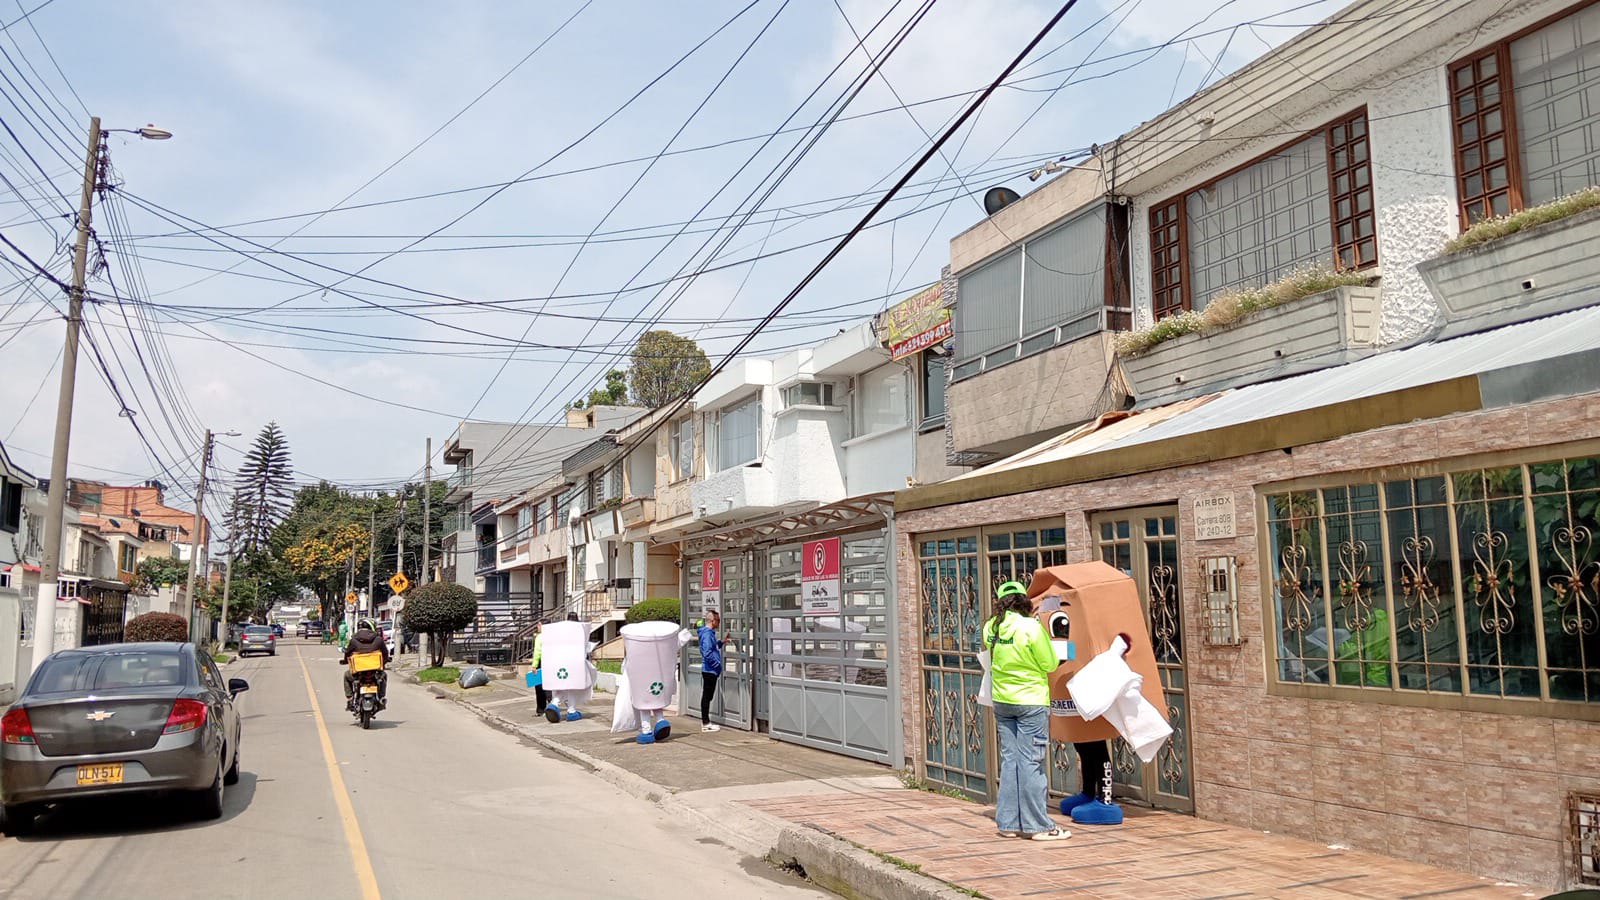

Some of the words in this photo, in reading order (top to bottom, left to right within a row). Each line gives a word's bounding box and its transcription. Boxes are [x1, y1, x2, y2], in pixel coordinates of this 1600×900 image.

[1195, 497, 1231, 508] AIRBOX
[102, 765, 122, 778] 517
[1101, 761, 1112, 805] adidas
